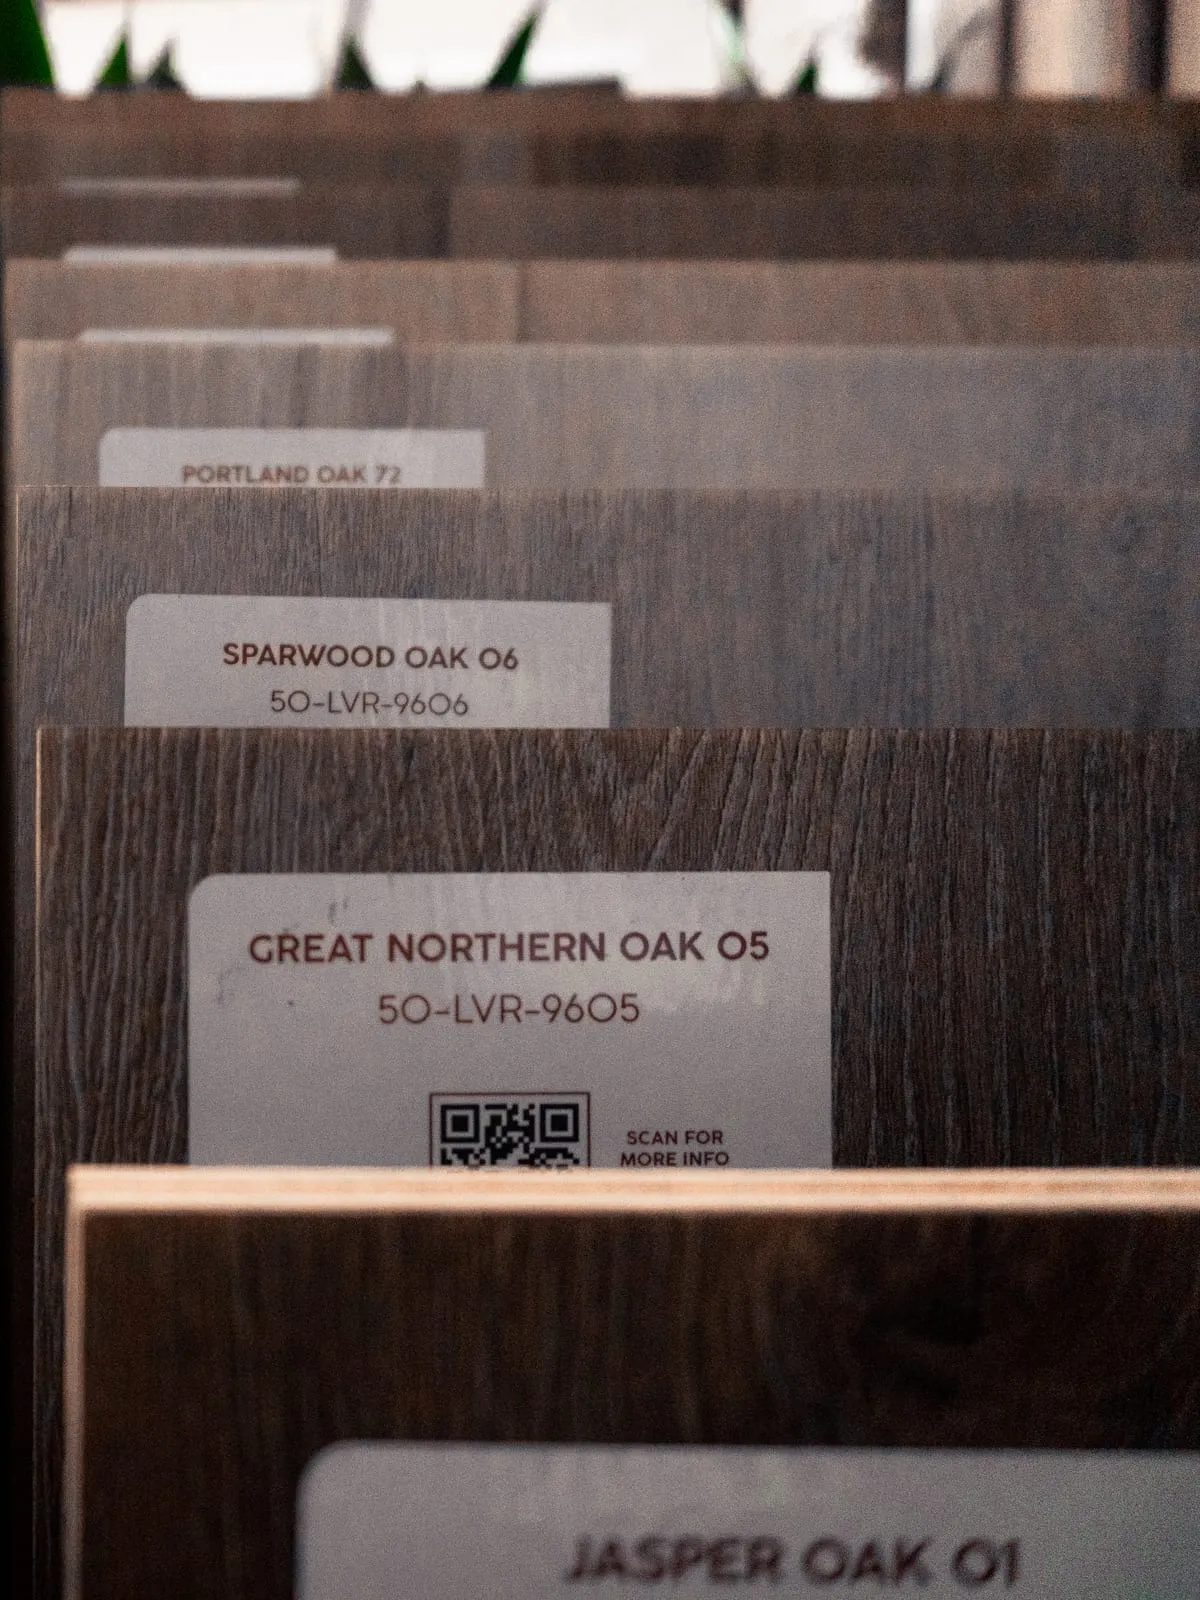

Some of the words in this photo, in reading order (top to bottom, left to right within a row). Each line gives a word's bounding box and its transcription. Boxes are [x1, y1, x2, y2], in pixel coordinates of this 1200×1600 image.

[182, 464, 310, 484] PORTLAND
[317, 464, 367, 484] OAK
[375, 464, 402, 484] 72
[223, 643, 394, 668] SPARWOOD
[405, 645, 468, 669] OAK
[249, 933, 373, 964] GREAT
[387, 932, 606, 962] NORTHERN
[619, 932, 704, 961] OAK
[627, 1130, 678, 1145] SCAN
[685, 1130, 723, 1145] FOR
[620, 1151, 676, 1166] MORE
[684, 1151, 729, 1166] INFO
[565, 1535, 782, 1584] JASPER
[801, 1538, 930, 1585] OAK
